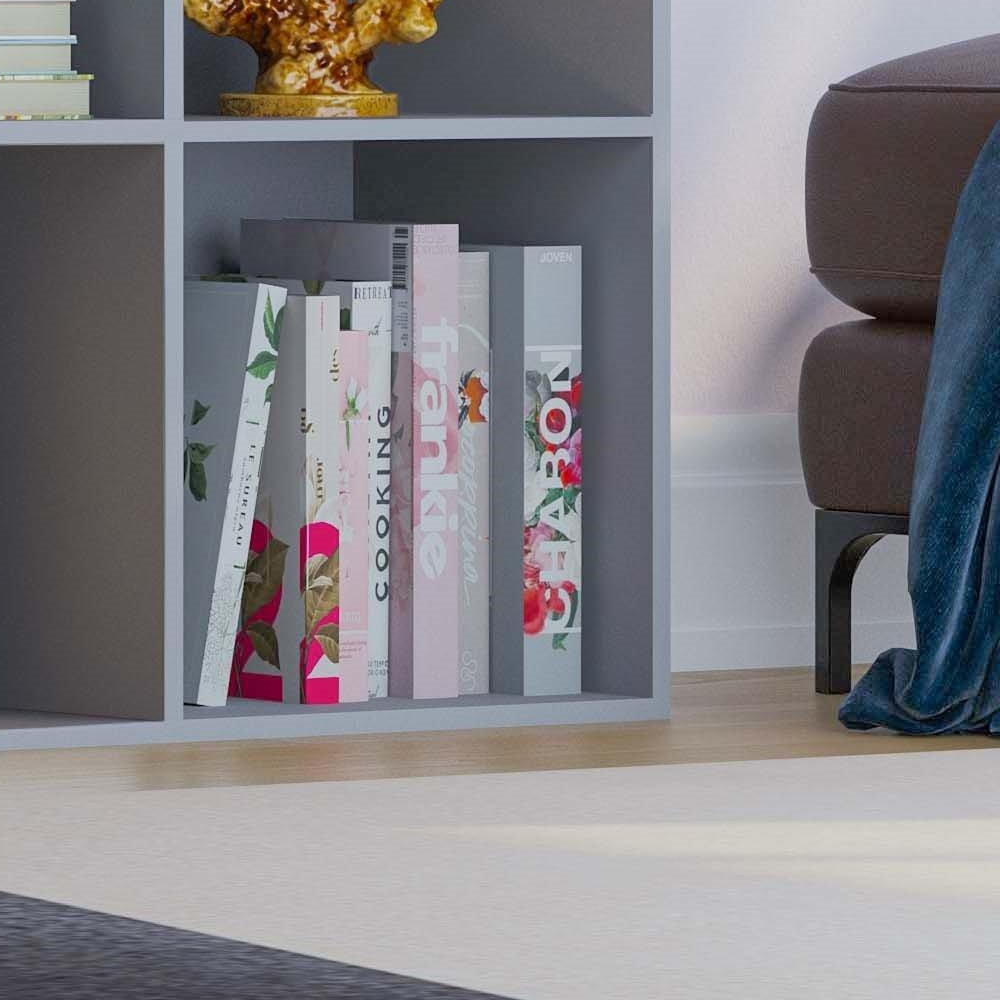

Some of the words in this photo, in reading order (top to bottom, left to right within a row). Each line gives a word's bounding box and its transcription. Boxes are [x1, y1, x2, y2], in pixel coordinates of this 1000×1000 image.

[375, 406, 391, 602] COOKING
[420, 317, 459, 579] frankie
[539, 351, 573, 630] CHABON
